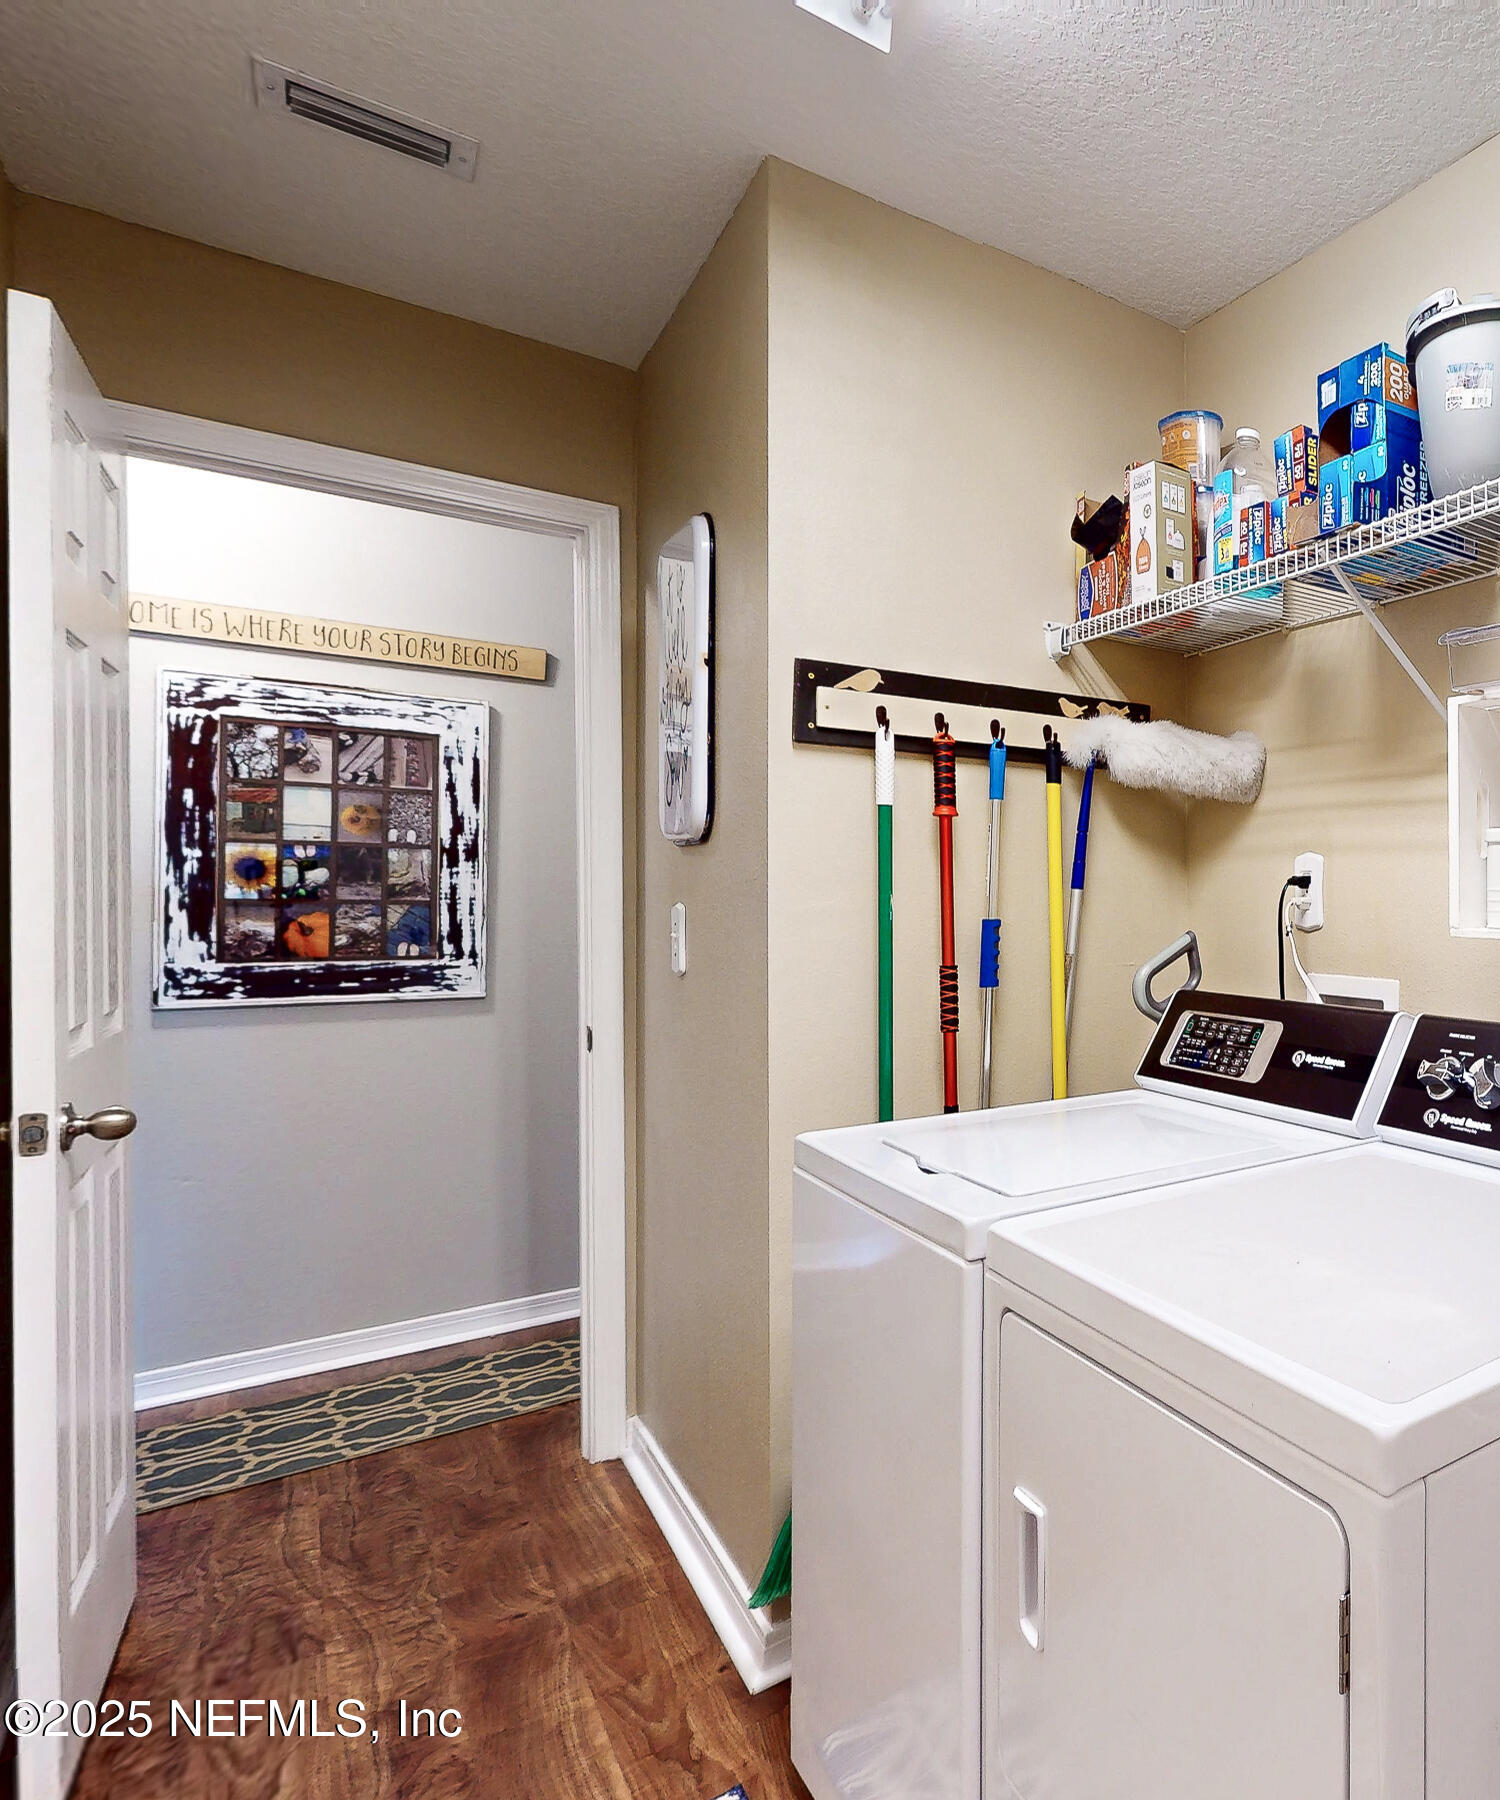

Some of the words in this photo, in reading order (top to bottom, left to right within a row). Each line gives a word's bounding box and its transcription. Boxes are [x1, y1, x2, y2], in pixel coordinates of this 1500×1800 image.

[1370, 362, 1378, 387] 200
[1389, 361, 1404, 403] 200
[1354, 402, 1370, 428] Zip
[1276, 458, 1289, 496] Ziploc
[1307, 437, 1318, 487] SLIDER
[1322, 483, 1336, 530] Ziploc
[1253, 507, 1264, 546] Ziploc
[1272, 517, 1284, 553] Ziploc
[129, 600, 182, 630] OME
[192, 607, 214, 634] IS
[223, 611, 305, 645] WHERE
[313, 624, 372, 653] YOUR
[379, 632, 445, 663] STORY
[452, 642, 519, 672] BEGINS
